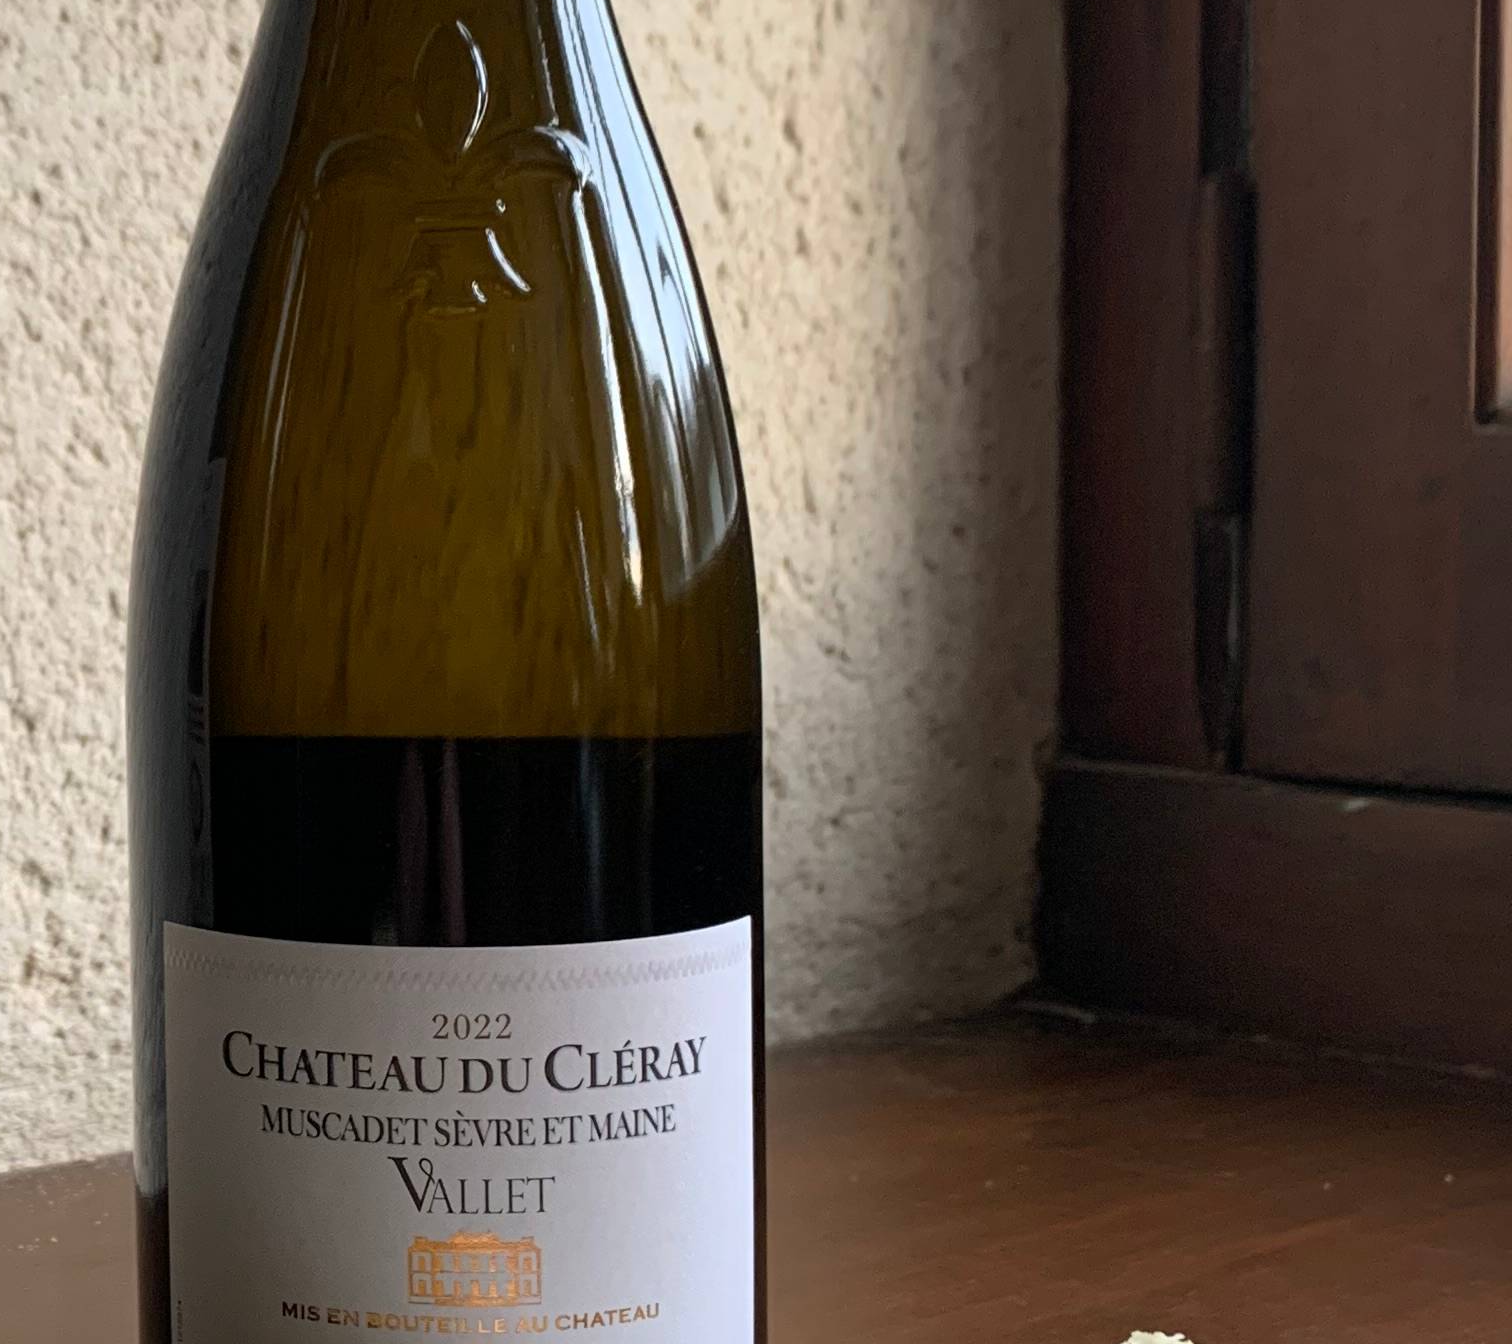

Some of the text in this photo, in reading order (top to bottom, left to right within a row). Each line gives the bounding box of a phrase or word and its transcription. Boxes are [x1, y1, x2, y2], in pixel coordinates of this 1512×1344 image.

[431, 1013, 512, 1041] 2022
[221, 1029, 707, 1094] CHATEAU DU CLÉRAY
[260, 1103, 677, 1148] MUSCADET SÈVRE ET MAINE
[388, 1156, 555, 1215] VALLET
[281, 1301, 661, 1335] MIS EN BOUTEILLE AU CHATEAU
